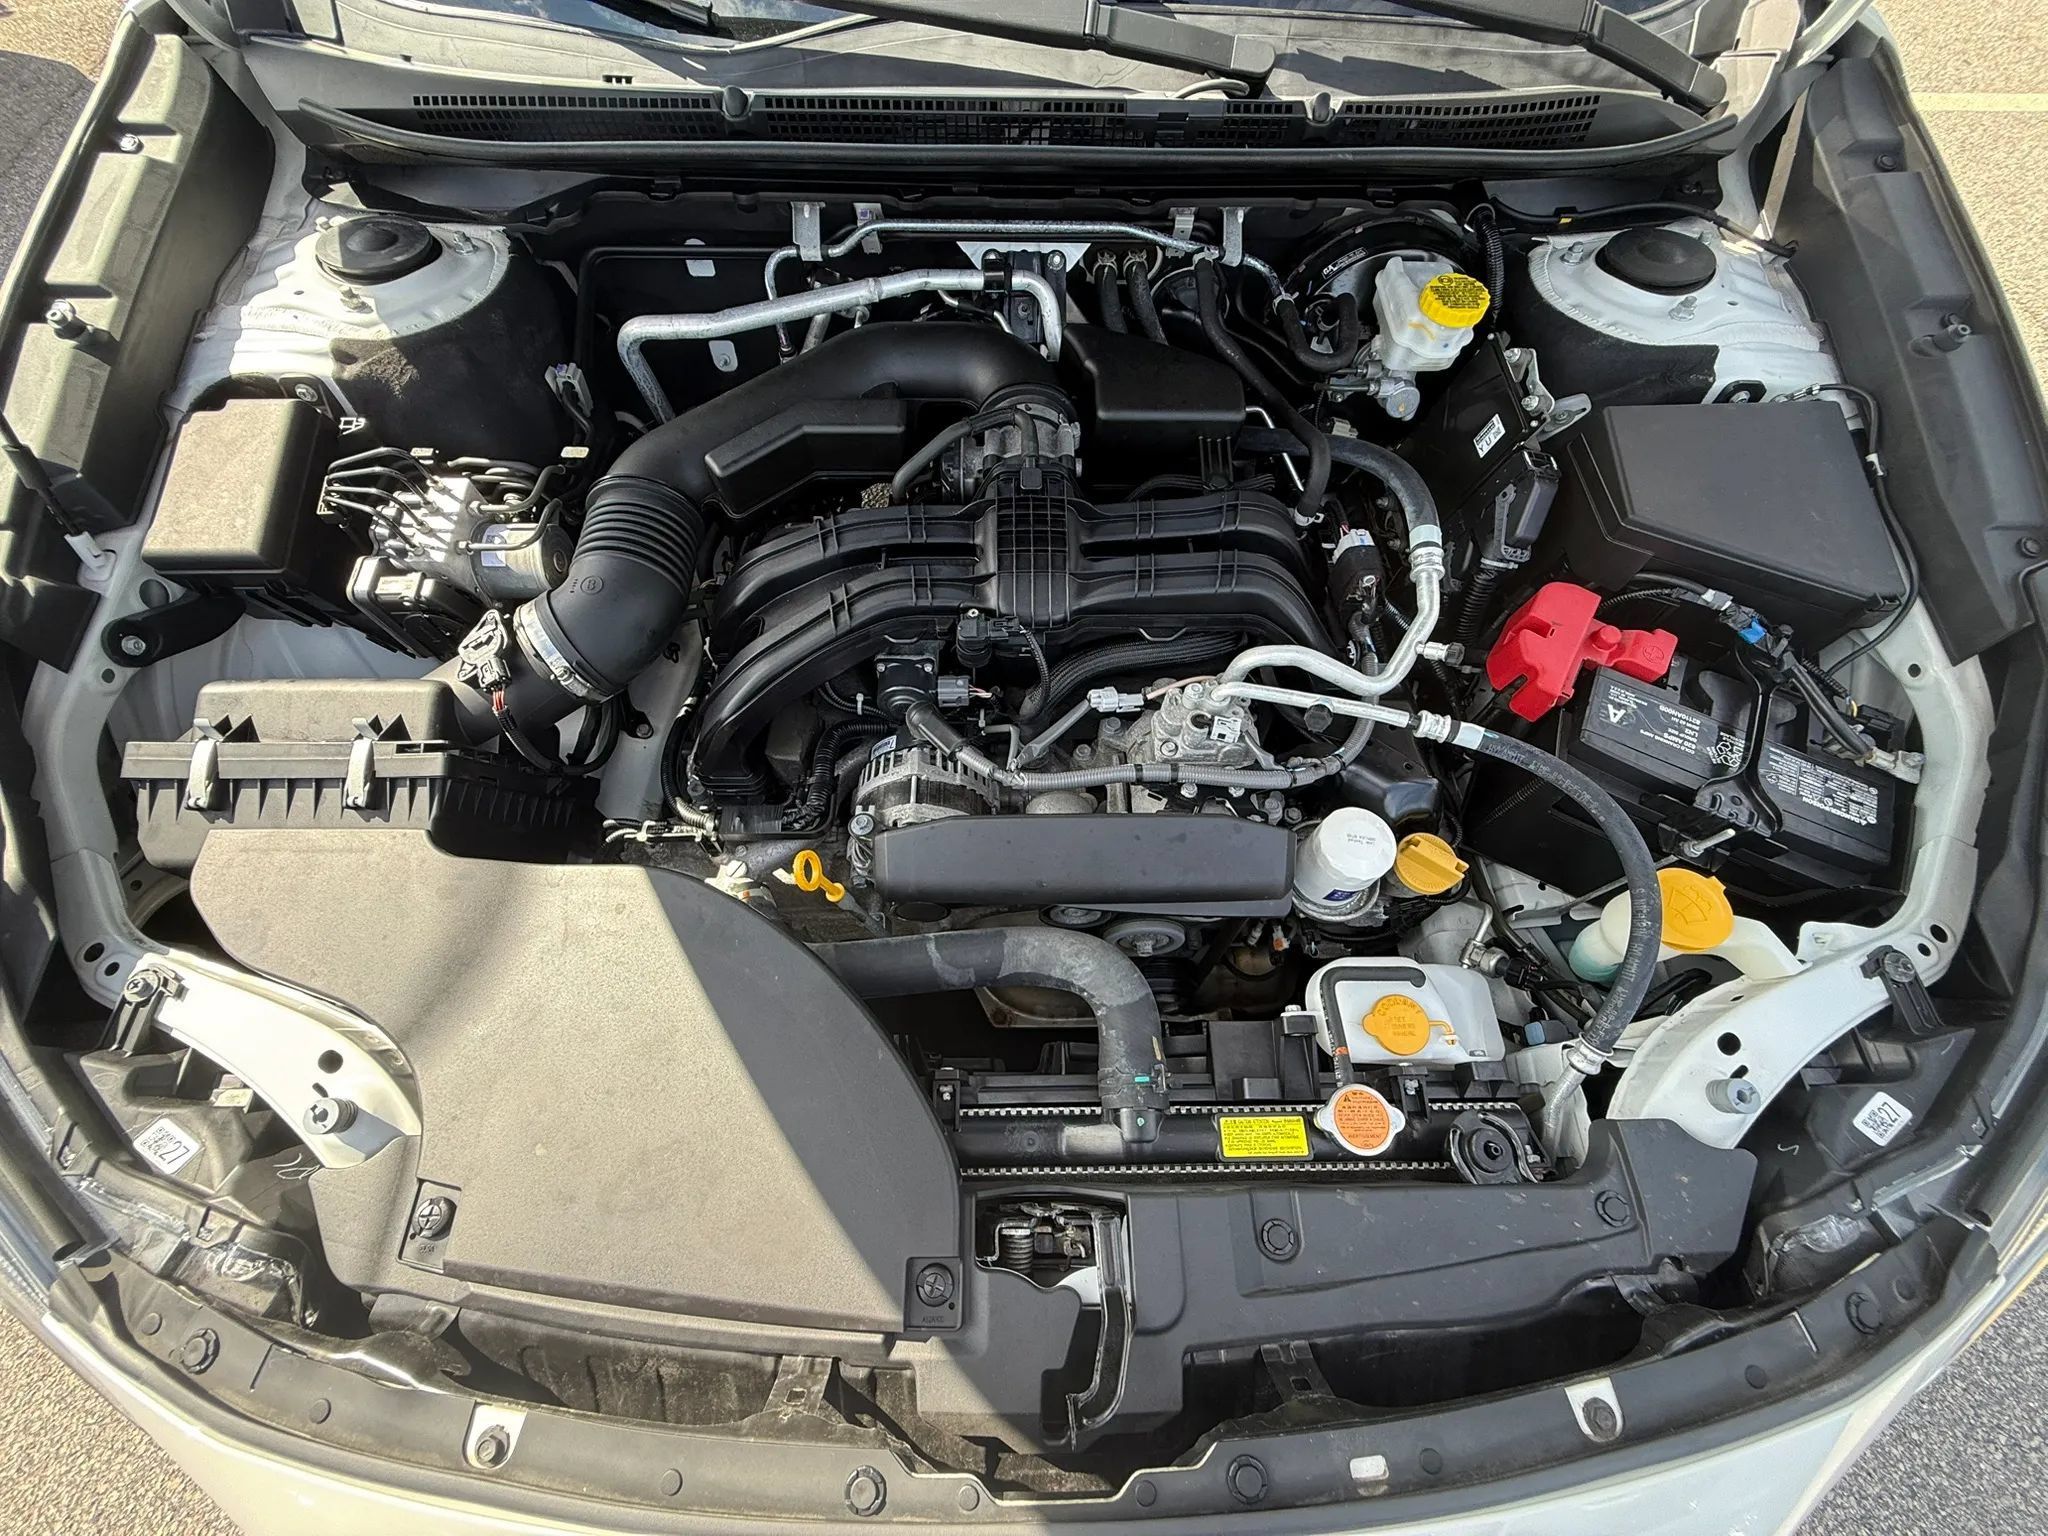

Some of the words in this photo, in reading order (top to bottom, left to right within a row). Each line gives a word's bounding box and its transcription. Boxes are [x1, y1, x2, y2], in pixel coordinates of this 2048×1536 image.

[1607, 703, 1626, 723] A
[1662, 732, 1683, 744] AMPS
[1877, 1102, 1901, 1123] 27
[158, 1141, 190, 1165] 27
